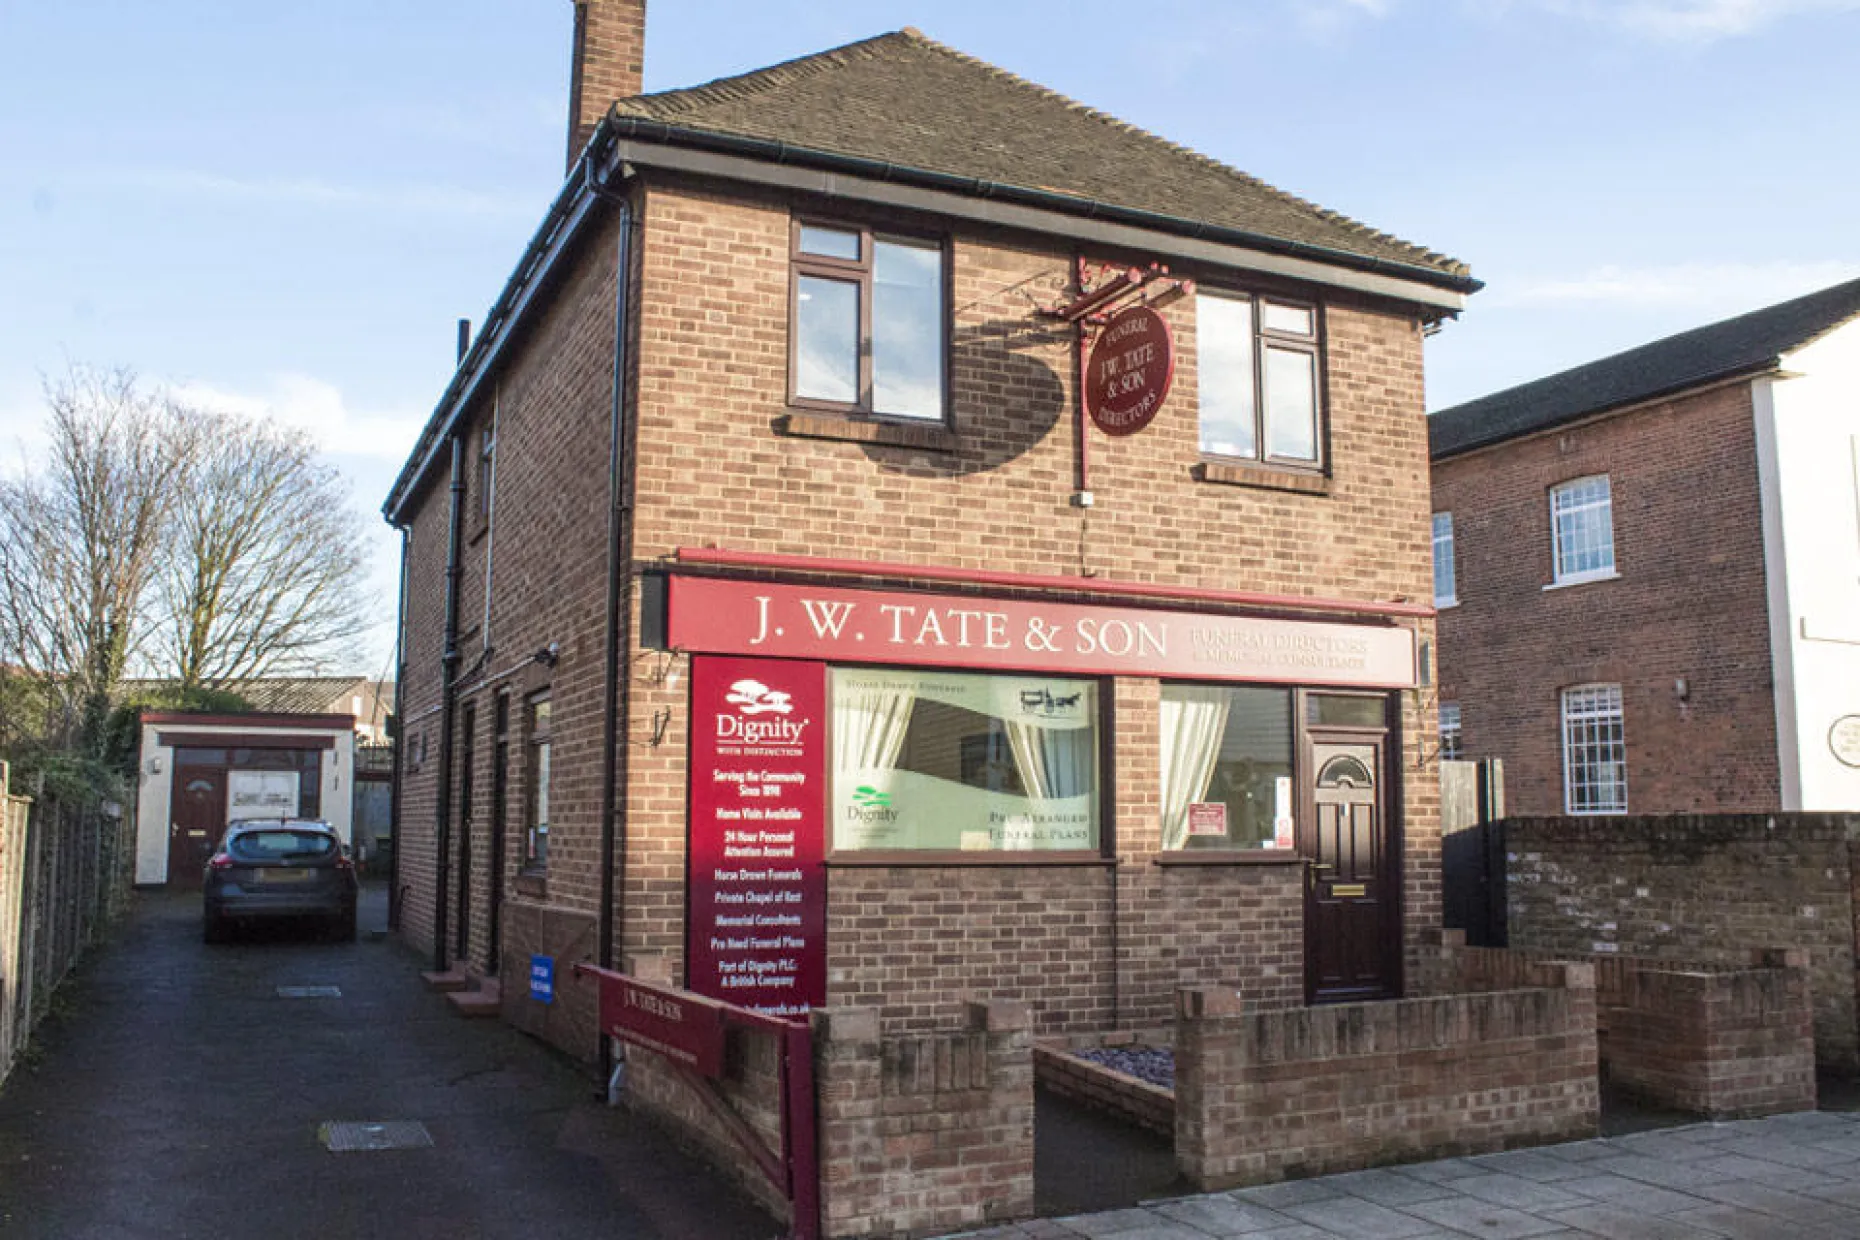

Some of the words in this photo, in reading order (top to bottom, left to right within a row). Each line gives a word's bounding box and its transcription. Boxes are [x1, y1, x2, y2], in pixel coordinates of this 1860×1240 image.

[1124, 342, 1154, 370] TATE
[1107, 380, 1118, 399] &
[1121, 367, 1146, 394] SON
[750, 596, 785, 644] J.
[800, 599, 866, 642] W.
[880, 603, 1010, 649] TATE
[1024, 615, 1065, 653] &
[1075, 619, 1168, 658] SON
[716, 714, 804, 743] Dignity
